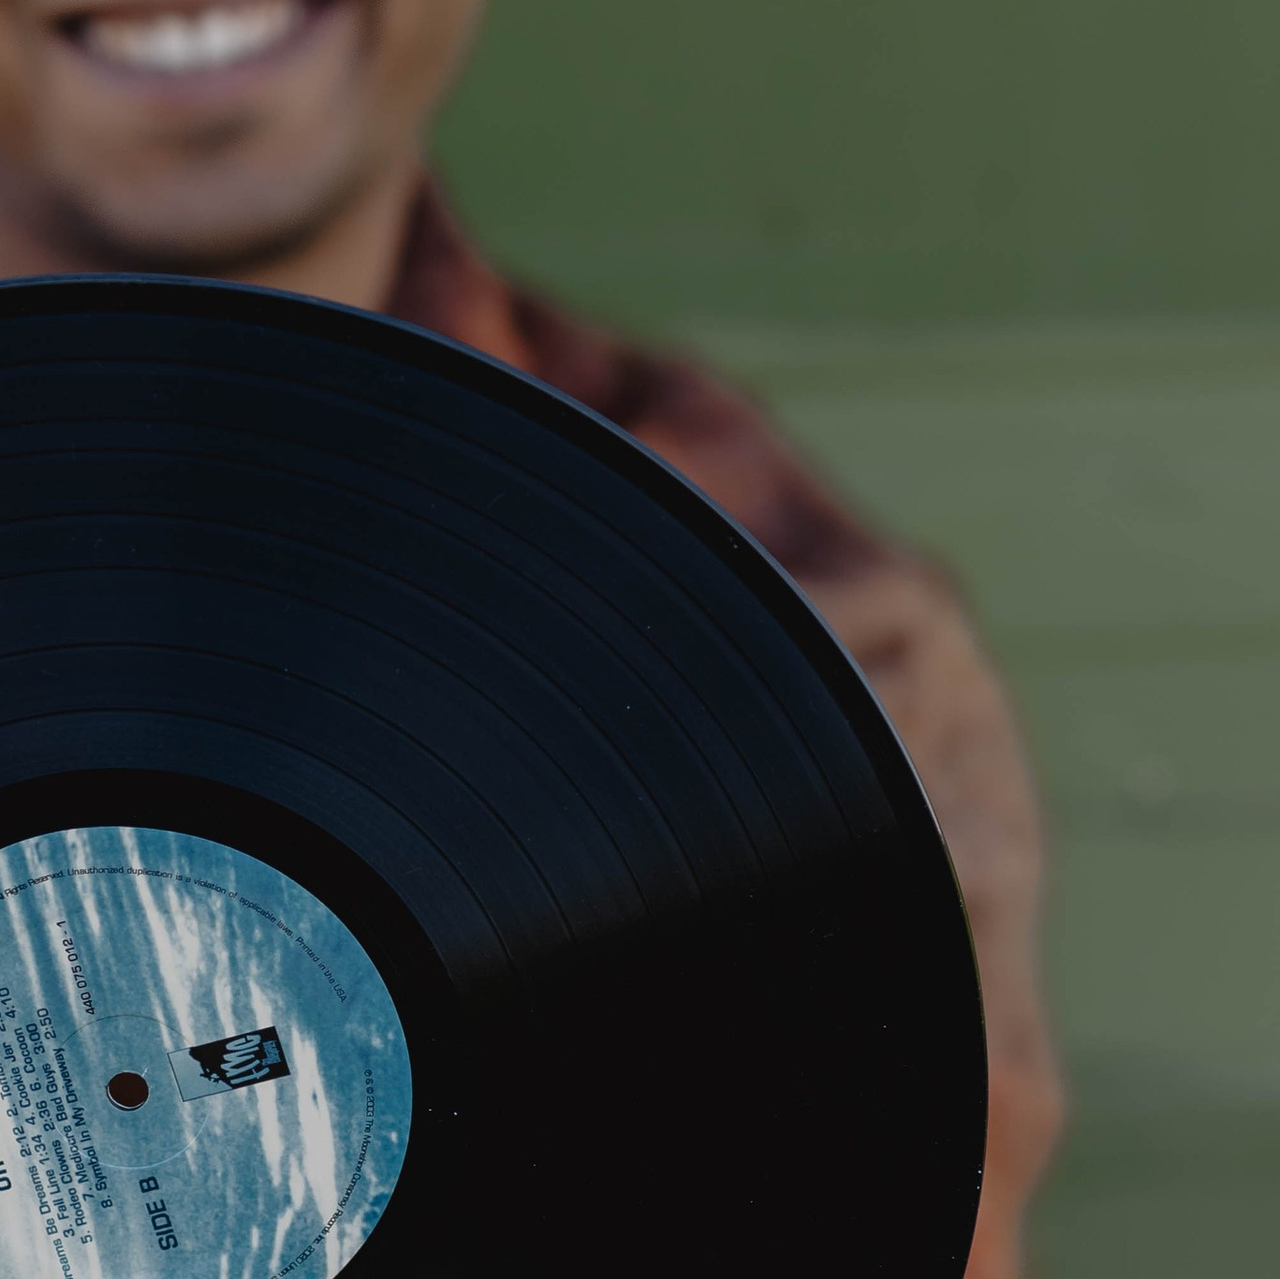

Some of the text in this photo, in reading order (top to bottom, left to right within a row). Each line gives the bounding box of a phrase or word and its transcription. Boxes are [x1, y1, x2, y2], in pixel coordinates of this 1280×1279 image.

[66, 865, 124, 876] Unauthorized
[126, 866, 173, 879] duplication
[3, 882, 27, 897] Rights
[193, 878, 227, 894] violation
[227, 890, 238, 899] of
[239, 896, 276, 923] applicable
[61, 937, 78, 962] 012
[294, 935, 320, 962] Printed
[70, 964, 87, 989] 075
[317, 962, 326, 971] in
[323, 969, 335, 984] the
[79, 991, 95, 1015] 440
[2, 1041, 16, 1062] Jar
[13, 1027, 35, 1074] Cocoon
[10, 1066, 31, 1108] Cookie
[29, 1077, 42, 1092] 6.
[5, 1102, 19, 1117] 2.
[24, 1111, 36, 1125] 4.
[25, 1022, 95, 1201] 7. Mediocre Bad Guys 3:00
[35, 1099, 56, 1131] 2:36
[36, 1007, 113, 1209] 8. Symbol In My Driveway 2:50
[365, 1095, 375, 1117] 2003
[363, 1118, 374, 1133] The
[11, 1125, 32, 1157] 2:12
[30, 1134, 49, 1165] 1:34
[354, 1134, 371, 1172] Moonshine
[51, 1139, 73, 1184] Clowns
[28, 1165, 51, 1215] Dreams
[45, 1168, 61, 1195] Line
[337, 1172, 361, 1208] Conspiracy
[52, 1197, 69, 1220] Fall
[67, 1187, 87, 1226] Rodeo
[138, 1175, 178, 1250] SIDE B
[45, 1217, 58, 1235] Be
[62, 1223, 75, 1238] 3.
[320, 1208, 343, 1234] Records
[80, 1229, 93, 1244] 5.
[294, 1244, 315, 1264] 2020
[276, 1261, 298, 1277] Union
